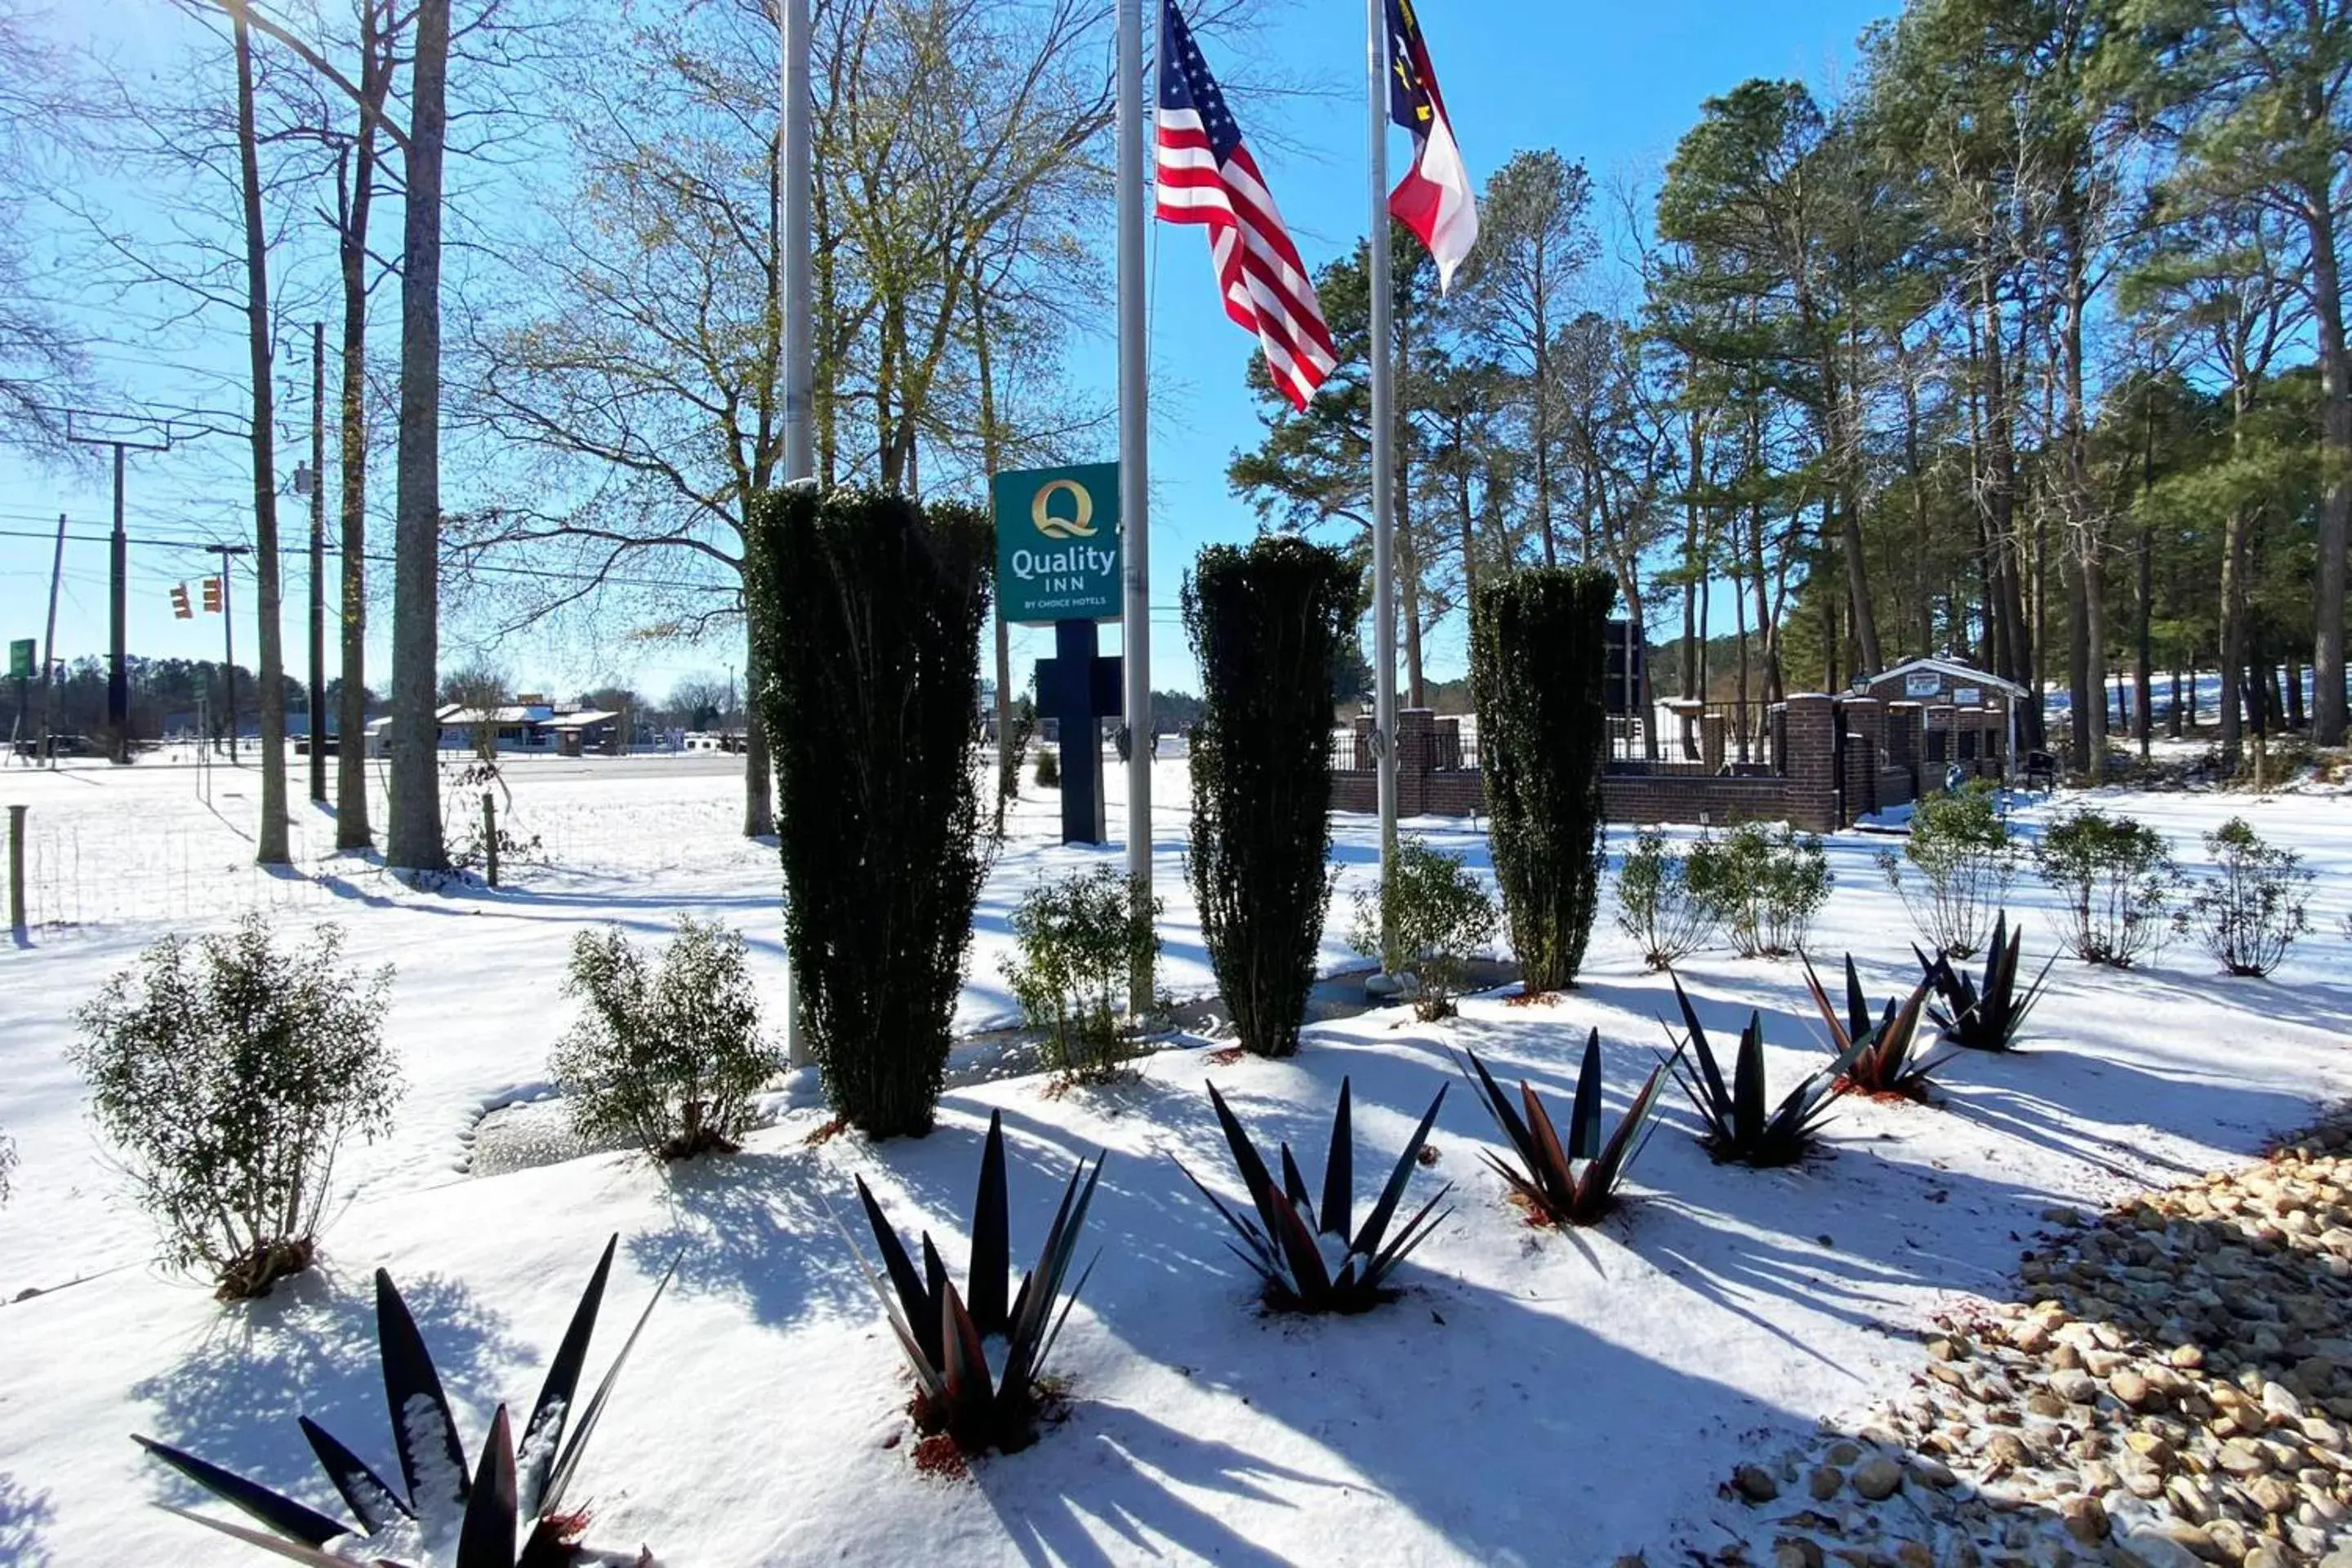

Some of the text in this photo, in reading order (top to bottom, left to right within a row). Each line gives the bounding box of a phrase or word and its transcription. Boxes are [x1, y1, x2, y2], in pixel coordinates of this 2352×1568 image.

[1032, 479, 1098, 539] Q
[1012, 546, 1116, 580] Quality
[1045, 575, 1085, 592] INN
[1024, 596, 1107, 609] BY CHOICE HOTELS
